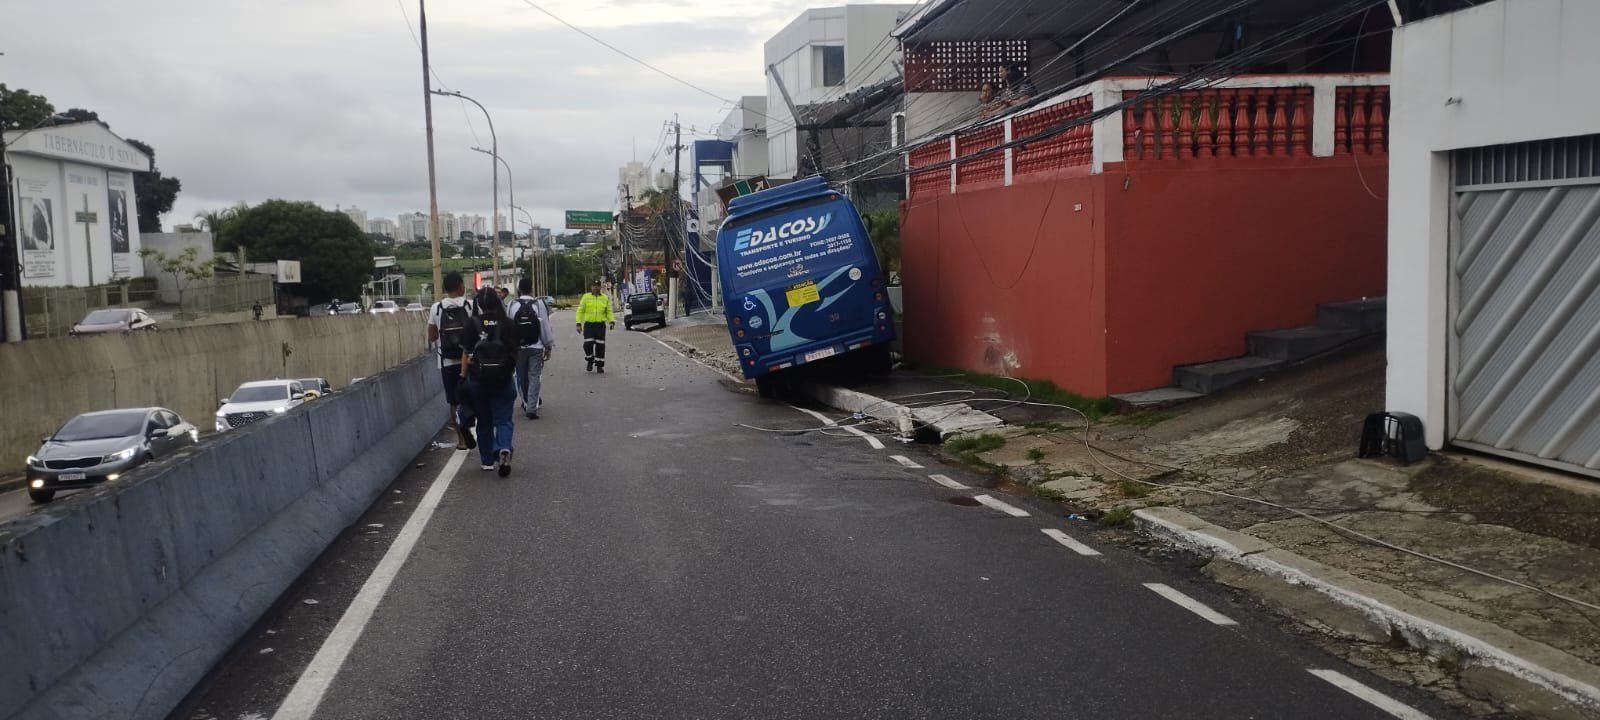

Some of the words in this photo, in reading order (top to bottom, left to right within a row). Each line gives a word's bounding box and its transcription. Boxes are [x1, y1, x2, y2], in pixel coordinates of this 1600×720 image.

[43, 133, 105, 159] TABERNÁCULO
[734, 216, 819, 252] EDACOS
[740, 242, 779, 257] TRANSPORTE
[784, 234, 811, 246] TURISMO
[736, 250, 802, 271] www.edacos.com.br
